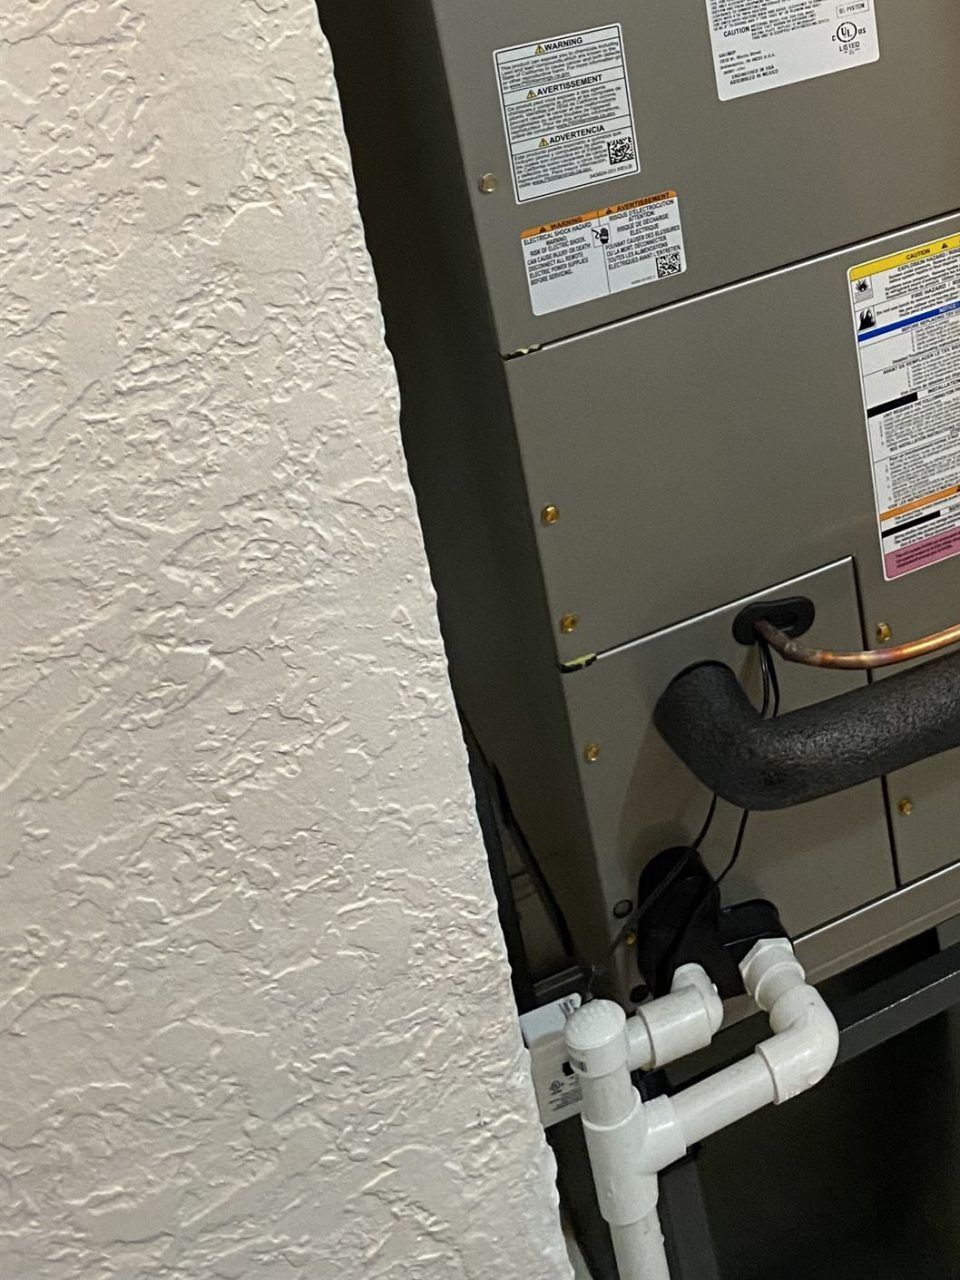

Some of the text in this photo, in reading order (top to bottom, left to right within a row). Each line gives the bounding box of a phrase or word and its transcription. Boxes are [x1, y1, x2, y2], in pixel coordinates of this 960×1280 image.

[723, 25, 750, 37] CAUTION
[544, 36, 582, 52] WARNING
[838, 40, 860, 52] LISTED
[536, 73, 602, 96] AVERTISSEMENT
[549, 123, 605, 144] ADVERTENCIA
[616, 192, 669, 211] AVERTISSEMENT
[550, 216, 583, 230] WARNING
[628, 210, 654, 221] ATTENTION
[523, 221, 591, 245] ELECTRICAL SHOCK HAZARD
[906, 247, 930, 260] CAUTION
